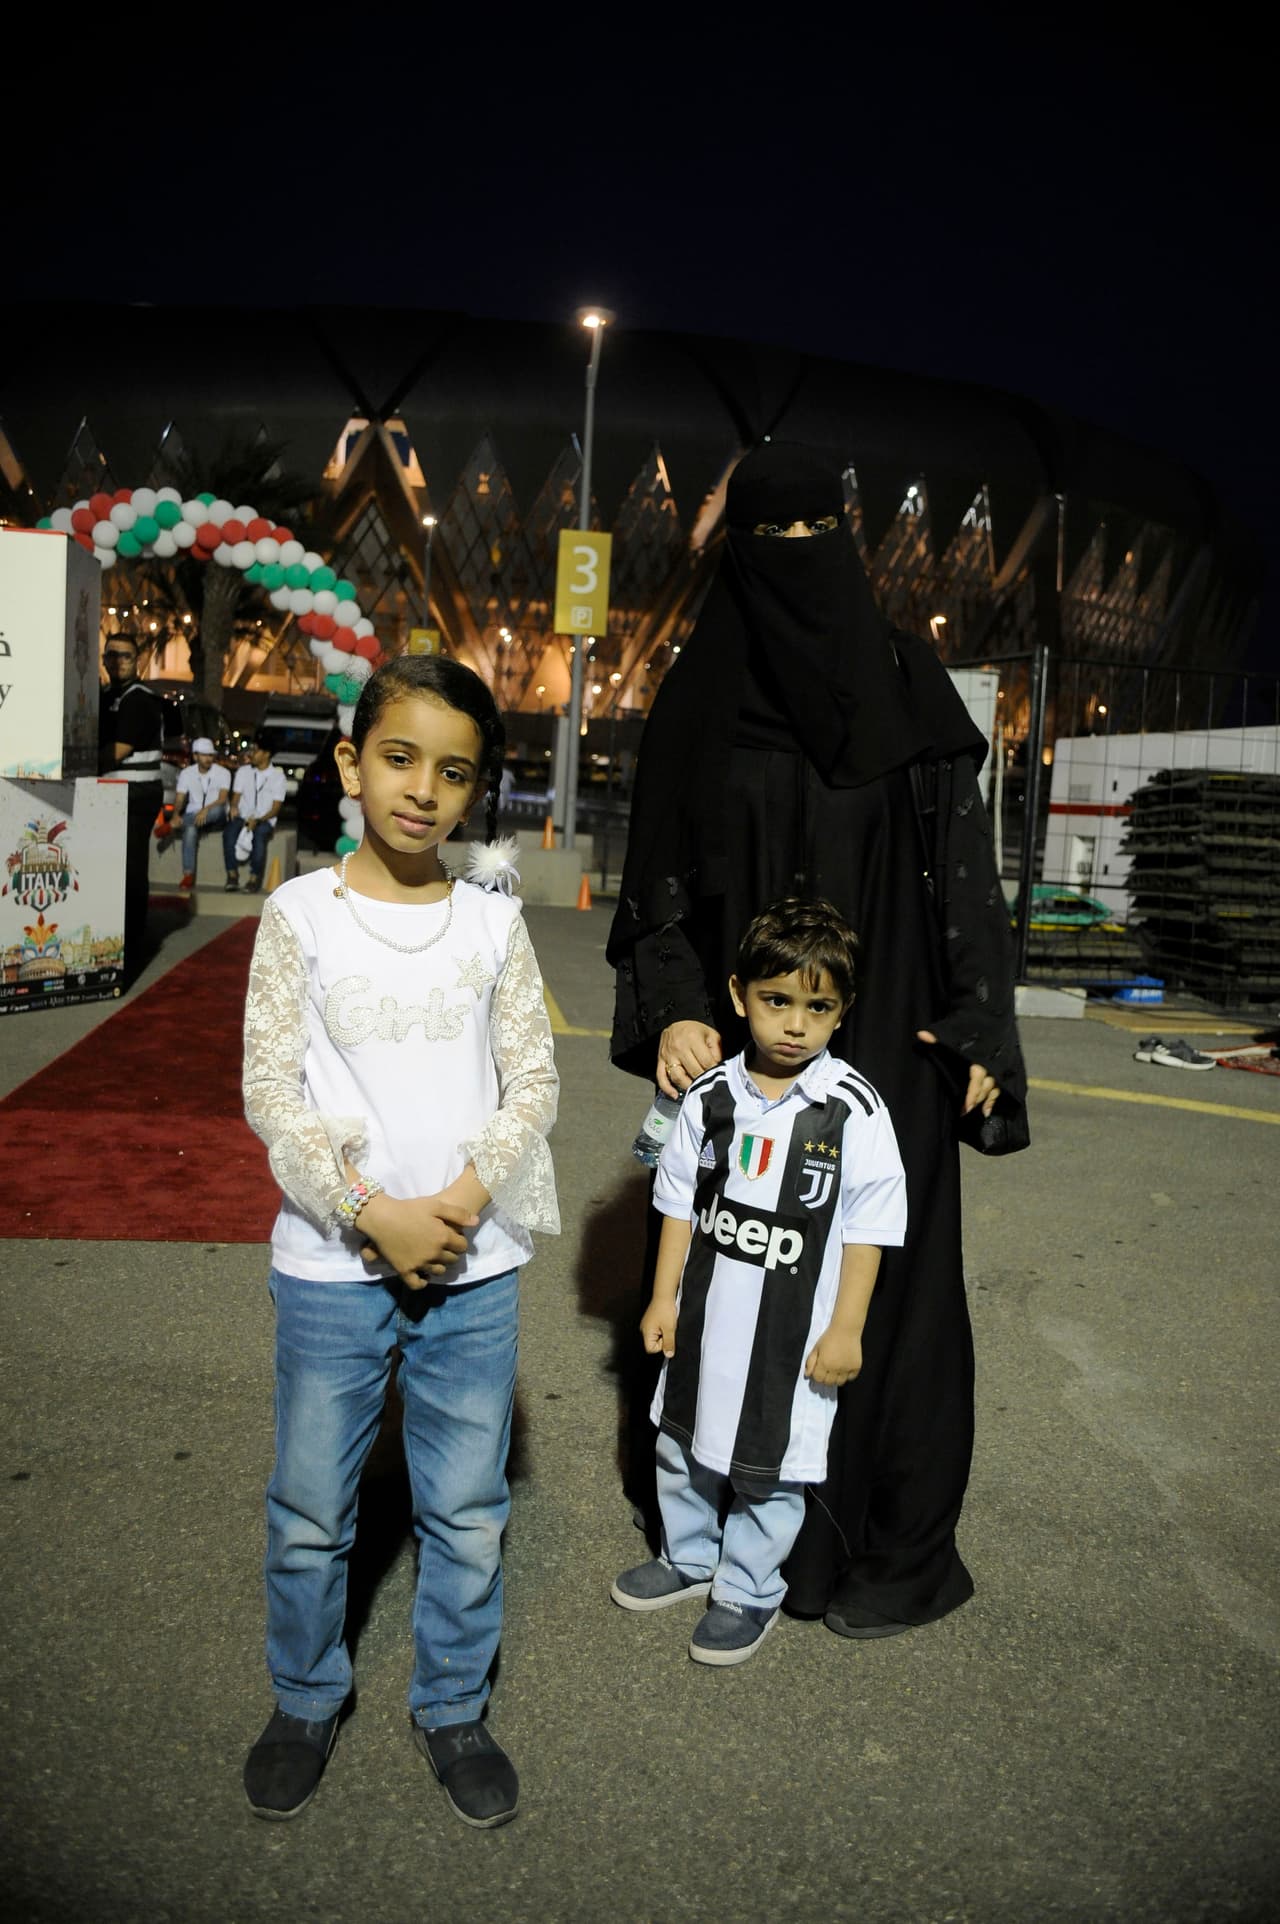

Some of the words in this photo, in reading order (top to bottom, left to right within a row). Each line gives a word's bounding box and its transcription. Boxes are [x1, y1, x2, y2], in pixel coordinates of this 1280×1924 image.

[569, 545, 598, 594] 3
[21, 871, 62, 892] ITALY
[325, 975, 472, 1047] Girls
[805, 1159, 836, 1171] JUVENTUS
[700, 1193, 803, 1270] Jeep
